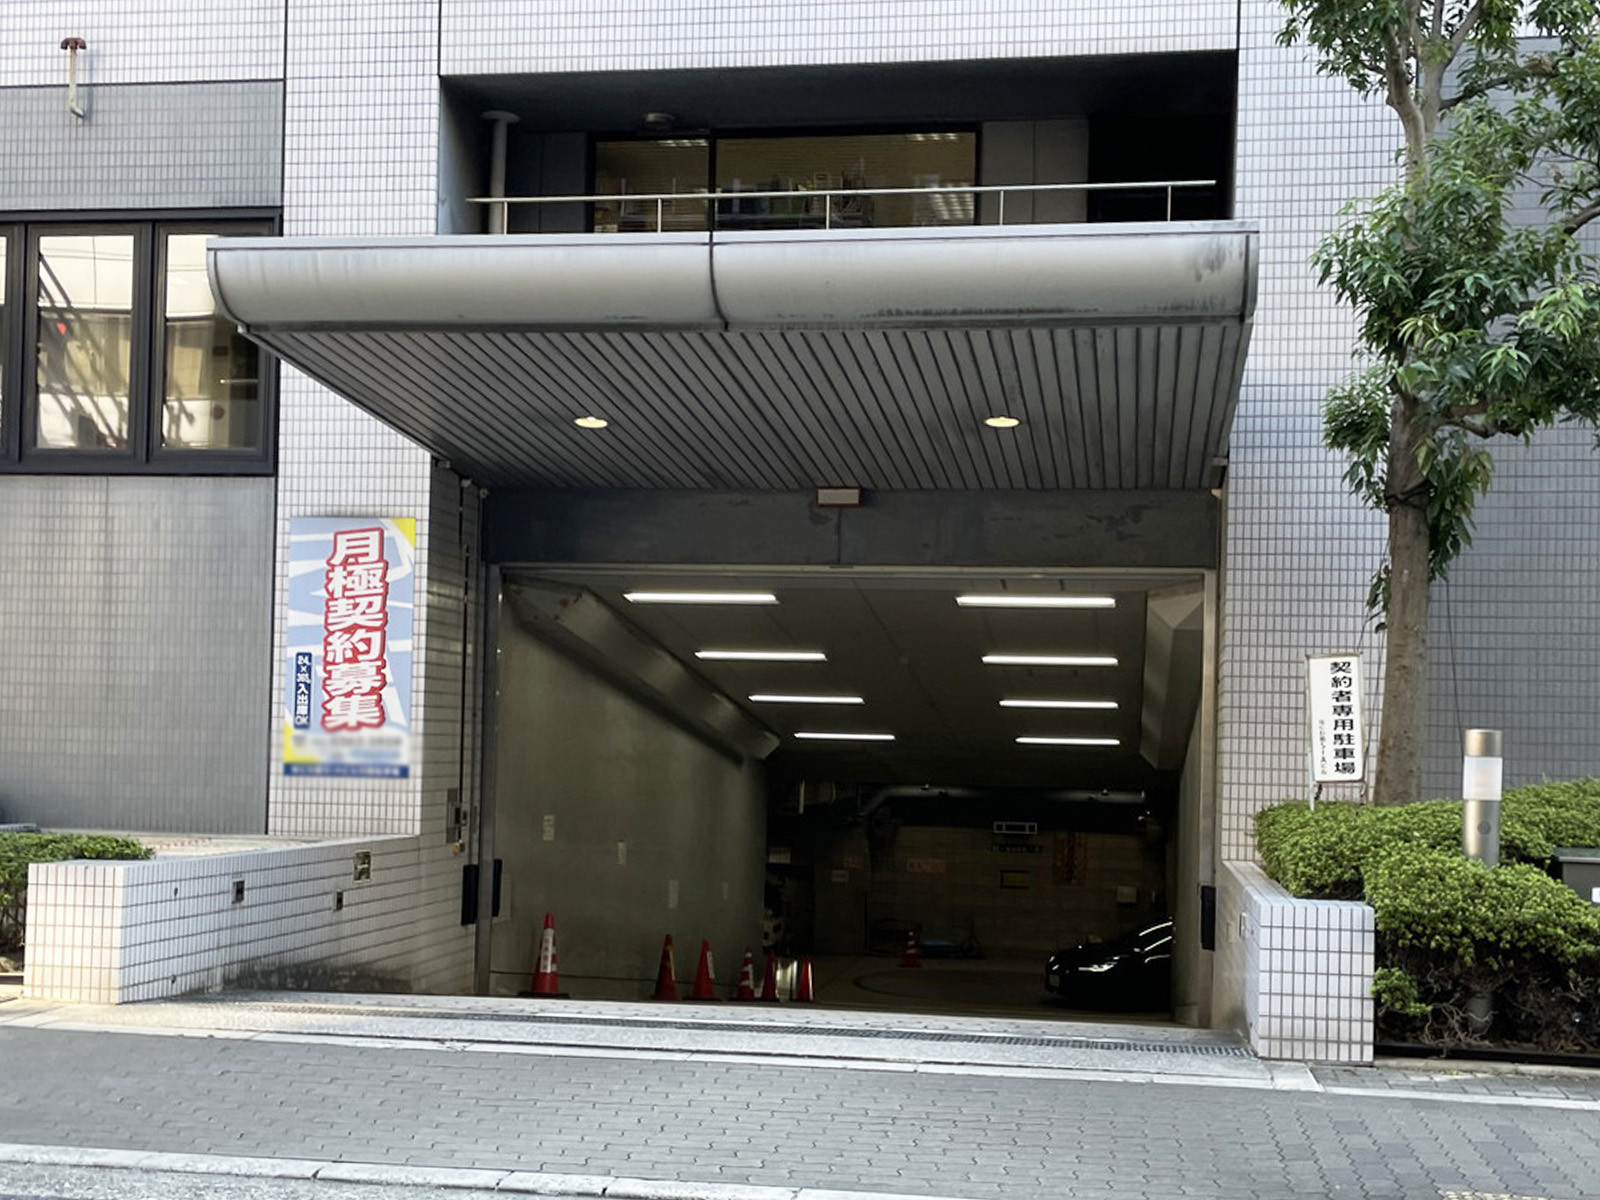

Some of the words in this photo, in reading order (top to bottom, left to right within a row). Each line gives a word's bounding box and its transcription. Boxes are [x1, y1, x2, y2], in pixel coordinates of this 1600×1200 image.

[323, 528, 387, 731] 月極契約募集
[1330, 661, 1356, 774] 契約者専用駐車場
